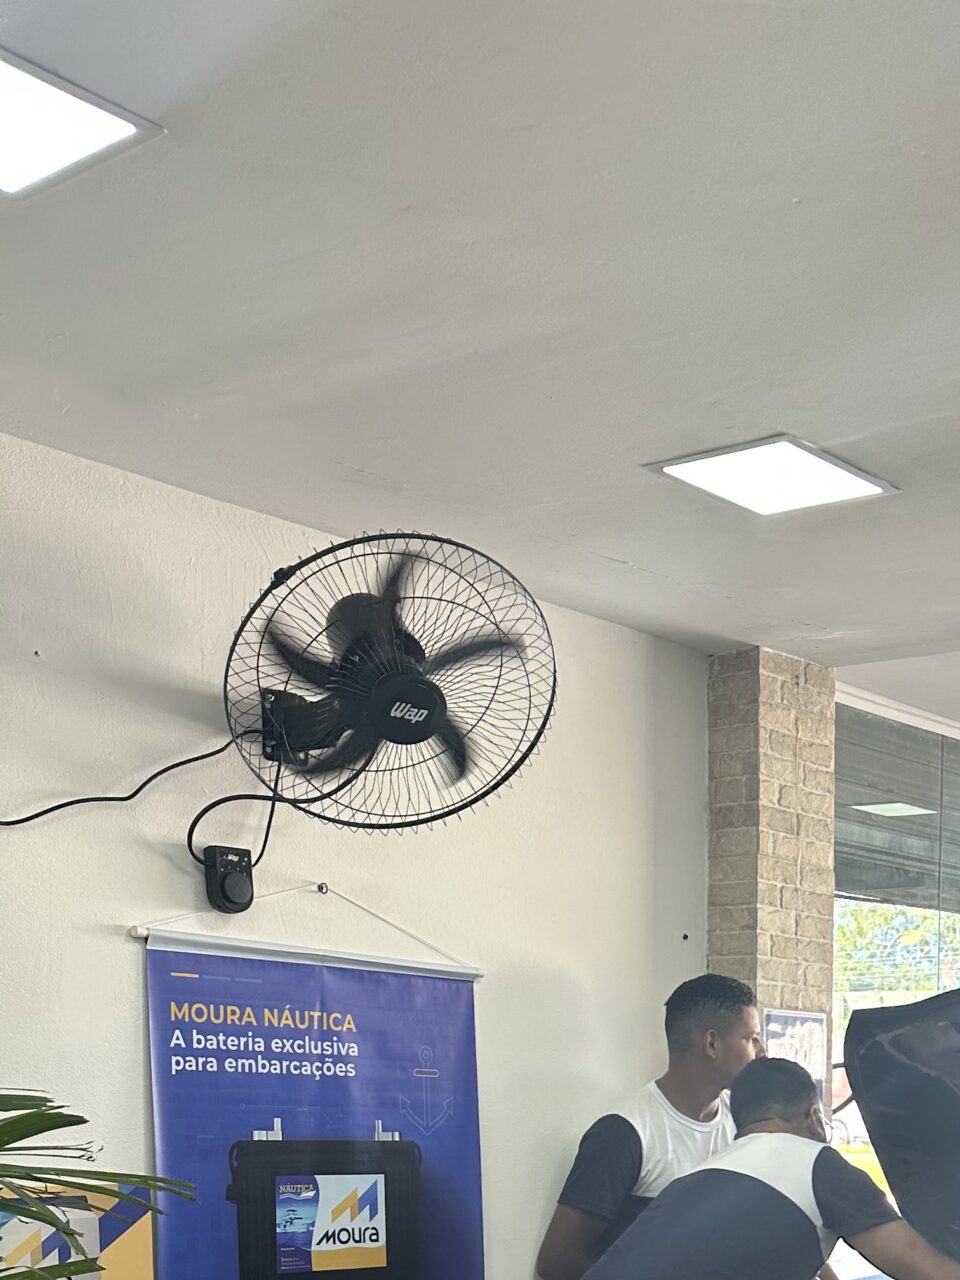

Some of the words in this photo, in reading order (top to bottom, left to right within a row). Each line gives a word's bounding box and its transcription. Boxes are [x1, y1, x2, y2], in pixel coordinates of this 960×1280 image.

[390, 701, 429, 724] Wap
[170, 1001, 258, 1026] MOURA
[264, 1004, 357, 1033] NÁUTICA
[169, 1029, 187, 1048] A
[192, 1029, 265, 1052] bateria
[271, 1036, 359, 1057] exclusiva
[171, 1055, 218, 1076] para
[224, 1055, 356, 1081] embarcações
[279, 1182, 315, 1193] NÁUTICA
